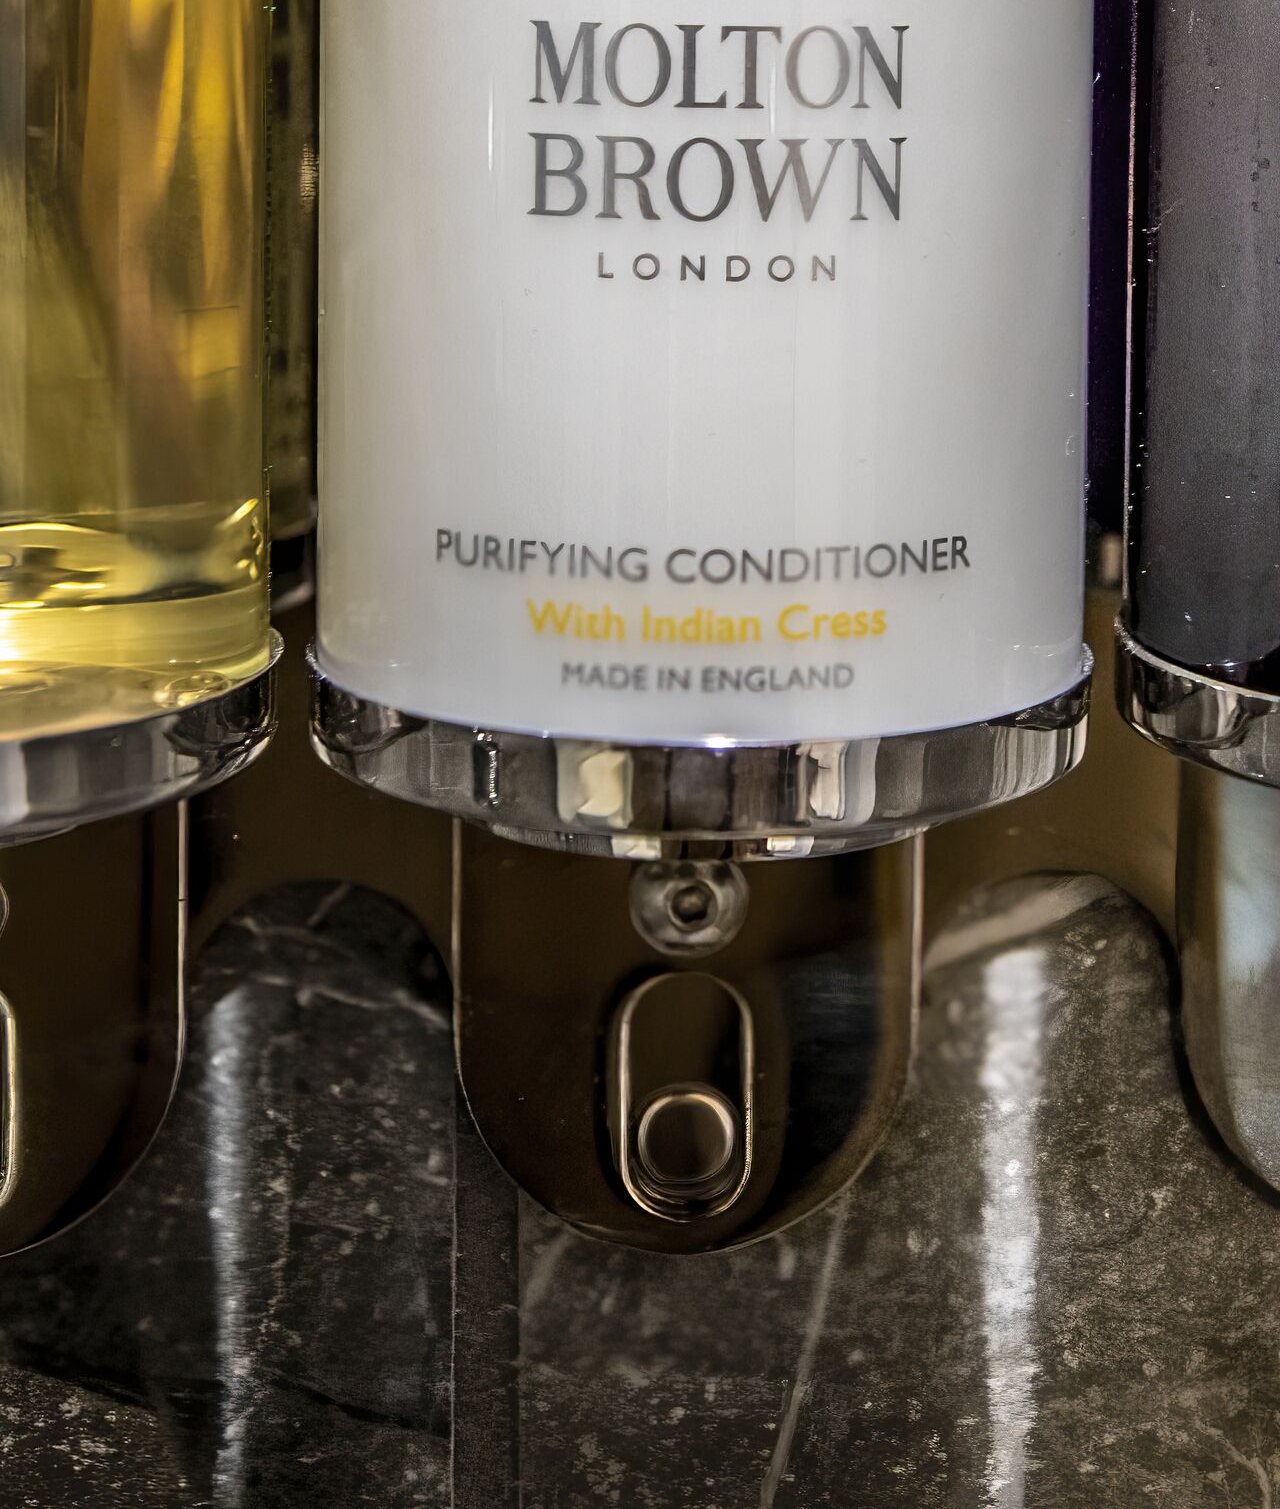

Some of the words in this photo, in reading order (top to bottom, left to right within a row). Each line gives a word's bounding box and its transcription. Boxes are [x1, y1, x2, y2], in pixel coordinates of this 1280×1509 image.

[528, 19, 910, 110] MOLTON
[526, 132, 908, 223] BROWN
[596, 251, 837, 283] LONDON
[436, 528, 649, 583] PURIFYING
[665, 535, 970, 585] CONDITIONER
[526, 598, 625, 644] With
[642, 605, 762, 645] Indian
[777, 604, 888, 643] Cress
[560, 662, 647, 693] MADE
[657, 664, 692, 692] IN
[700, 663, 855, 694] ENGLAND
